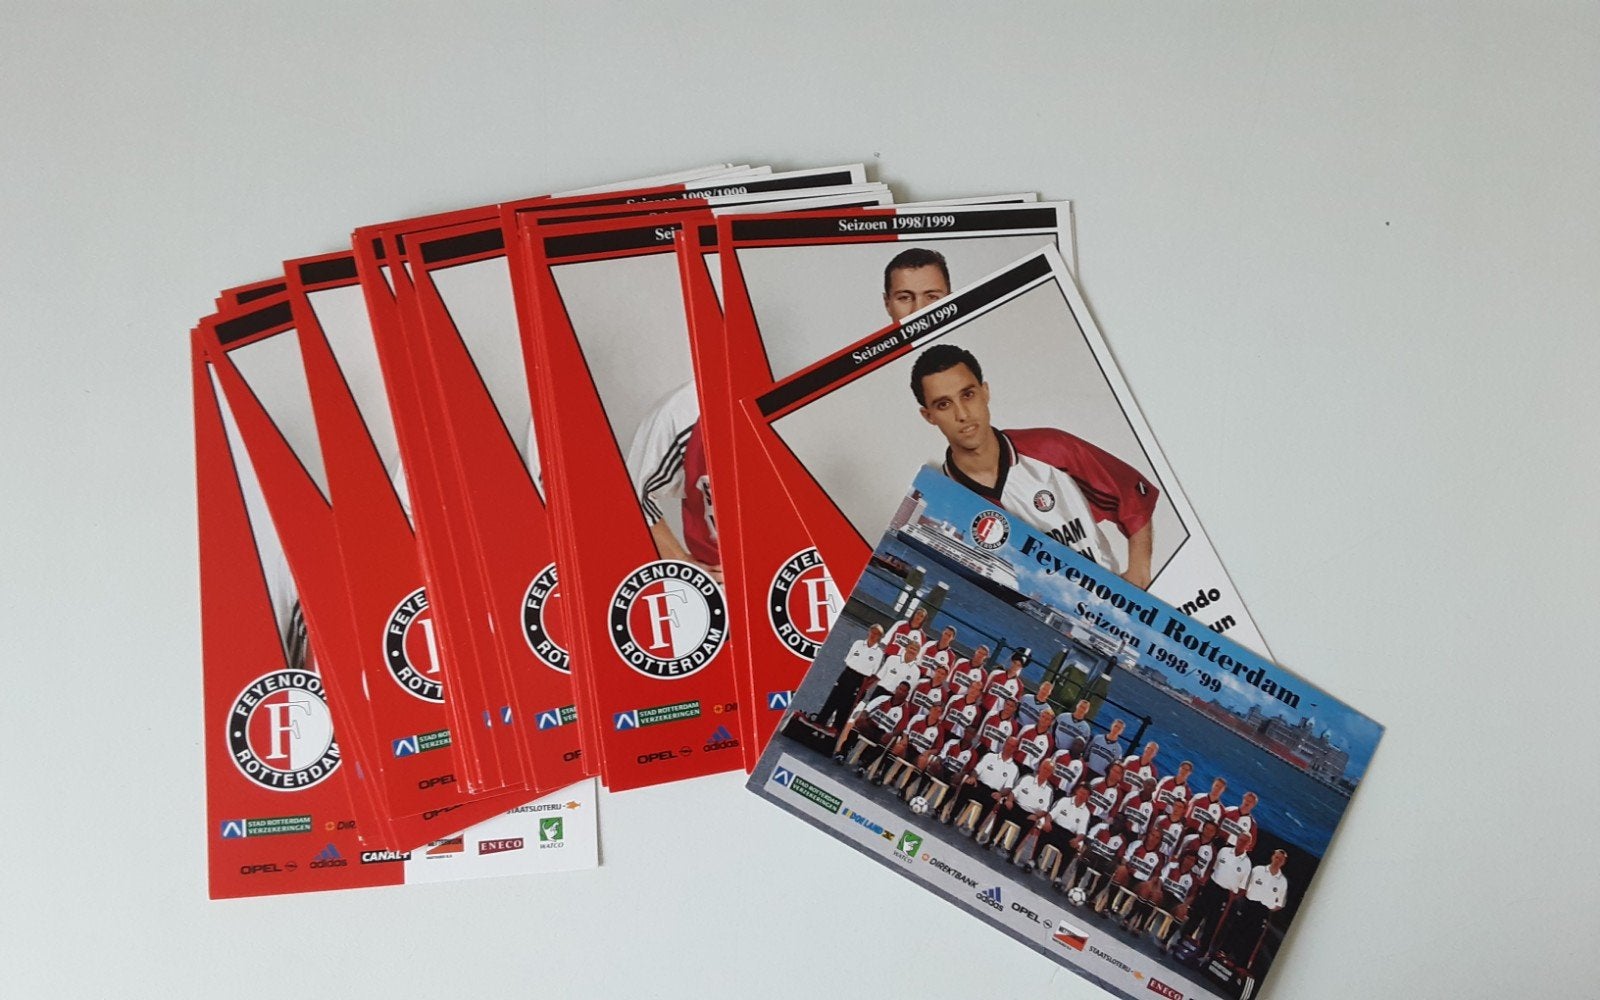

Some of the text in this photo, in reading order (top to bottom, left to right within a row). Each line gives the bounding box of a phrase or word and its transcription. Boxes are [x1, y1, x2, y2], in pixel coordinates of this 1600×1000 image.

[838, 215, 956, 231] Seizoen 1998/1999
[852, 303, 958, 364] Seizoen 1998/1999
[1045, 517, 1087, 546] DAM
[615, 564, 715, 610] FEYENOORD
[1176, 588, 1221, 616] ndo
[1019, 534, 1301, 710] Feyenoord Rotterdam
[1073, 602, 1141, 648] Seizoen
[621, 628, 722, 674] ROTTERDAM
[235, 674, 327, 717] FEYENOO
[639, 701, 700, 717] STAD ROTTERDAM
[640, 709, 700, 724] VERZEKERINGEN
[703, 739, 739, 752] adidas
[236, 742, 340, 787] ROTTERDAM
[637, 750, 678, 764] OPEL
[248, 817, 311, 828] STAD ROTTERDAM
[248, 824, 311, 834] VERZEKERINGEN
[481, 840, 522, 851] ENECO
[240, 864, 282, 875] OPEL
[929, 857, 979, 888] DIREKTBANK
[976, 892, 1004, 912] adidas
[1011, 902, 1041, 924] OPEL
